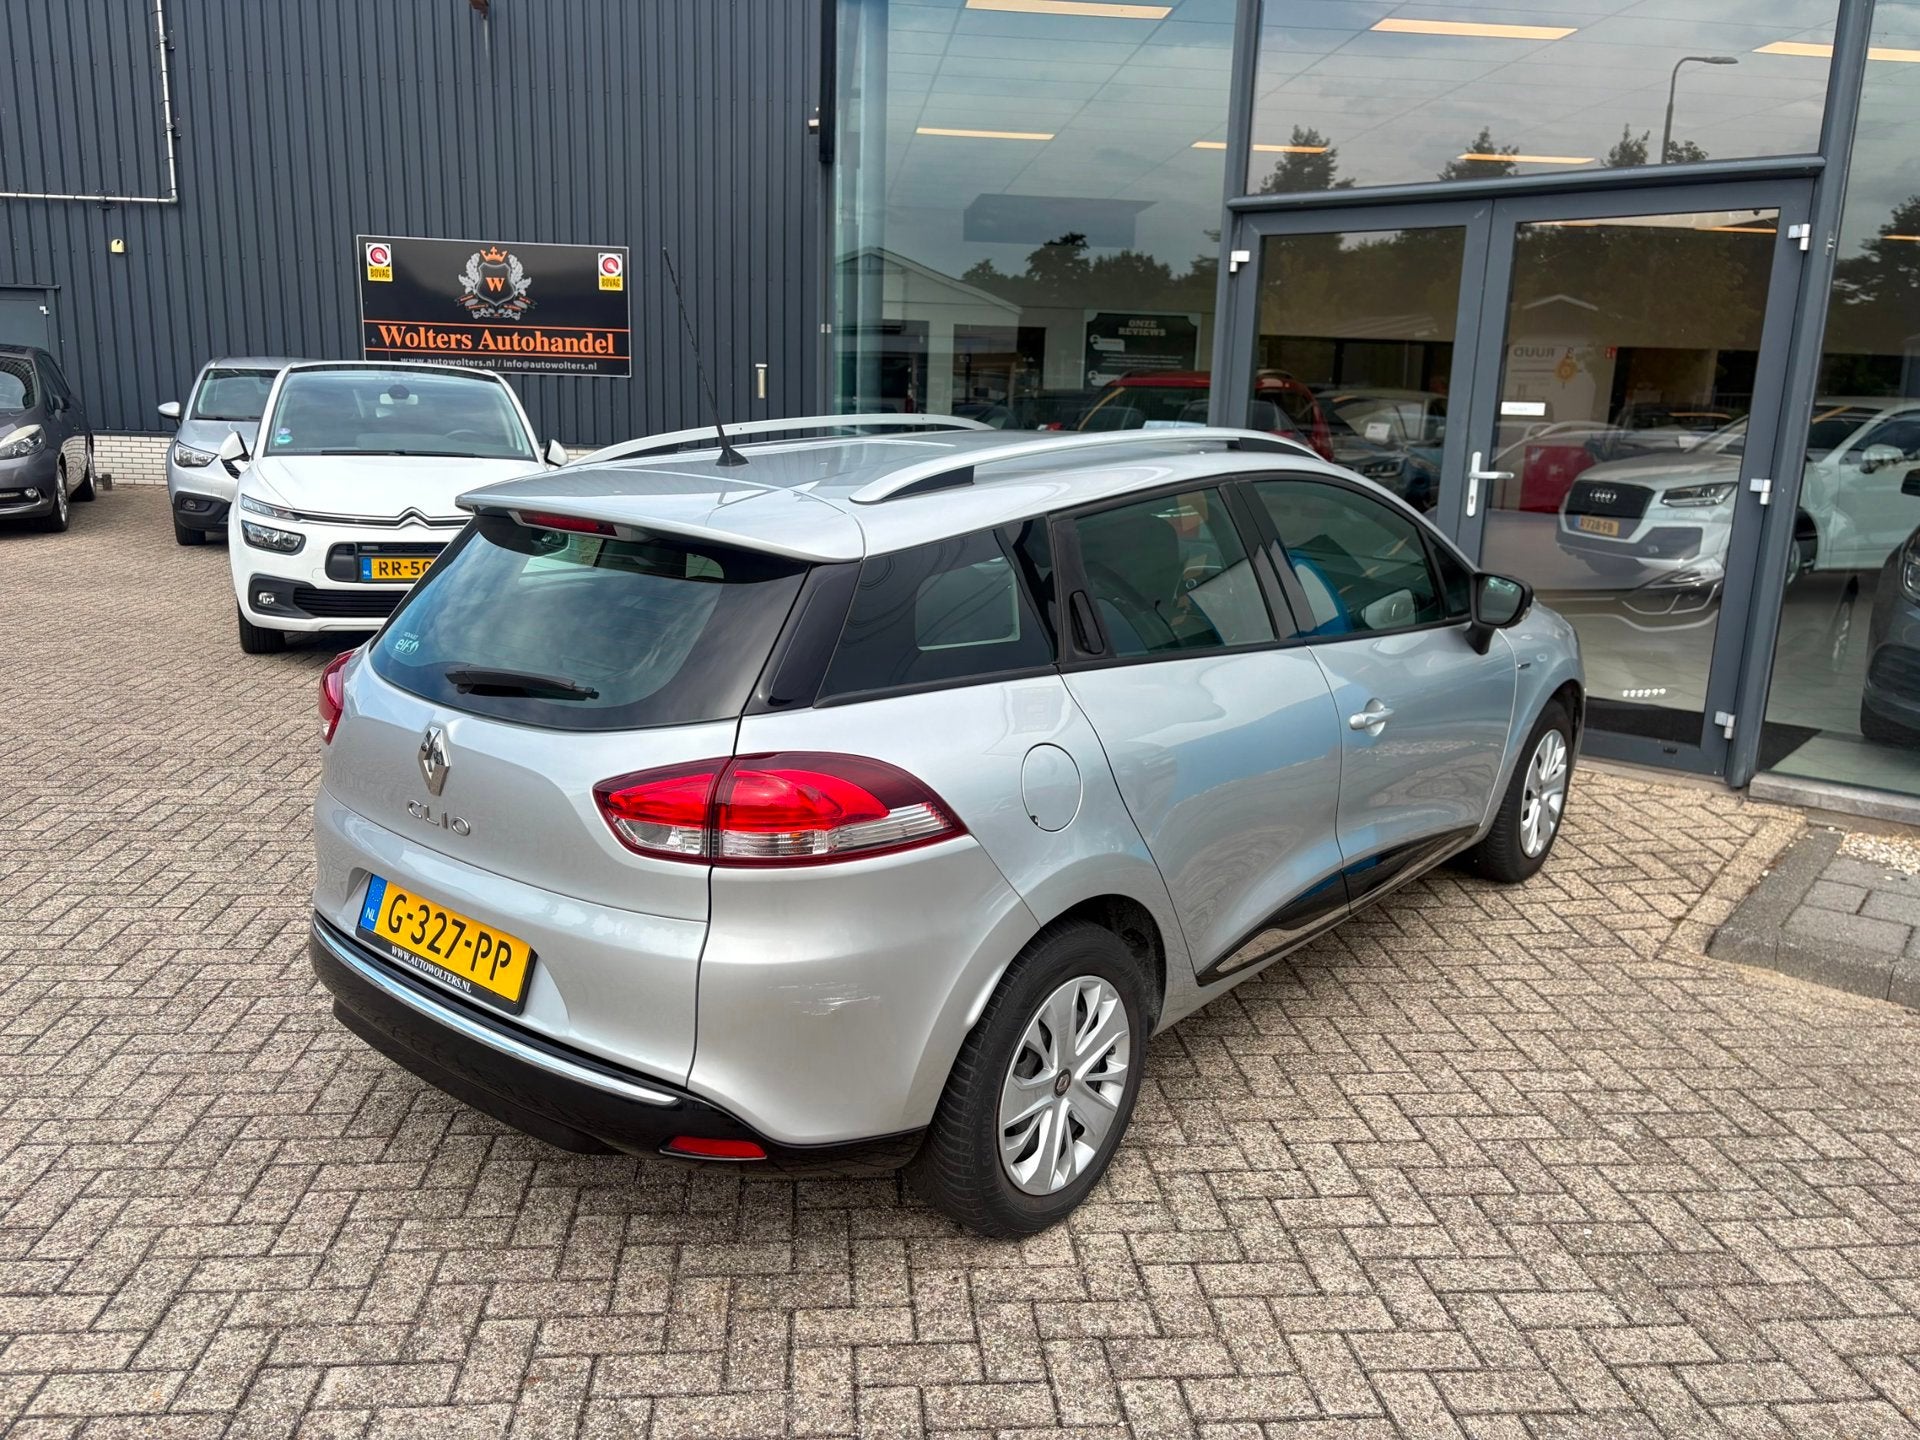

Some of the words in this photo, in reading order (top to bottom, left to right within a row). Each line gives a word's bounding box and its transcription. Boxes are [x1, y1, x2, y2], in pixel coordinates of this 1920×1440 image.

[370, 267, 391, 279] BOVAG
[485, 277, 505, 292] W
[601, 277, 621, 288] BOVAG
[1128, 319, 1157, 328] ONZE
[1118, 327, 1166, 336] REVIEWS
[378, 325, 473, 350] Wolters
[478, 329, 615, 354] Autohandel
[400, 357, 495, 368] www.autowolters.nl
[504, 359, 597, 370] info@autowolters.nl
[406, 799, 471, 836] CLIO
[365, 907, 375, 922] NL
[388, 893, 512, 981] G-327-PP
[391, 945, 472, 994] WWW.AUTOWOLTERS.NL
